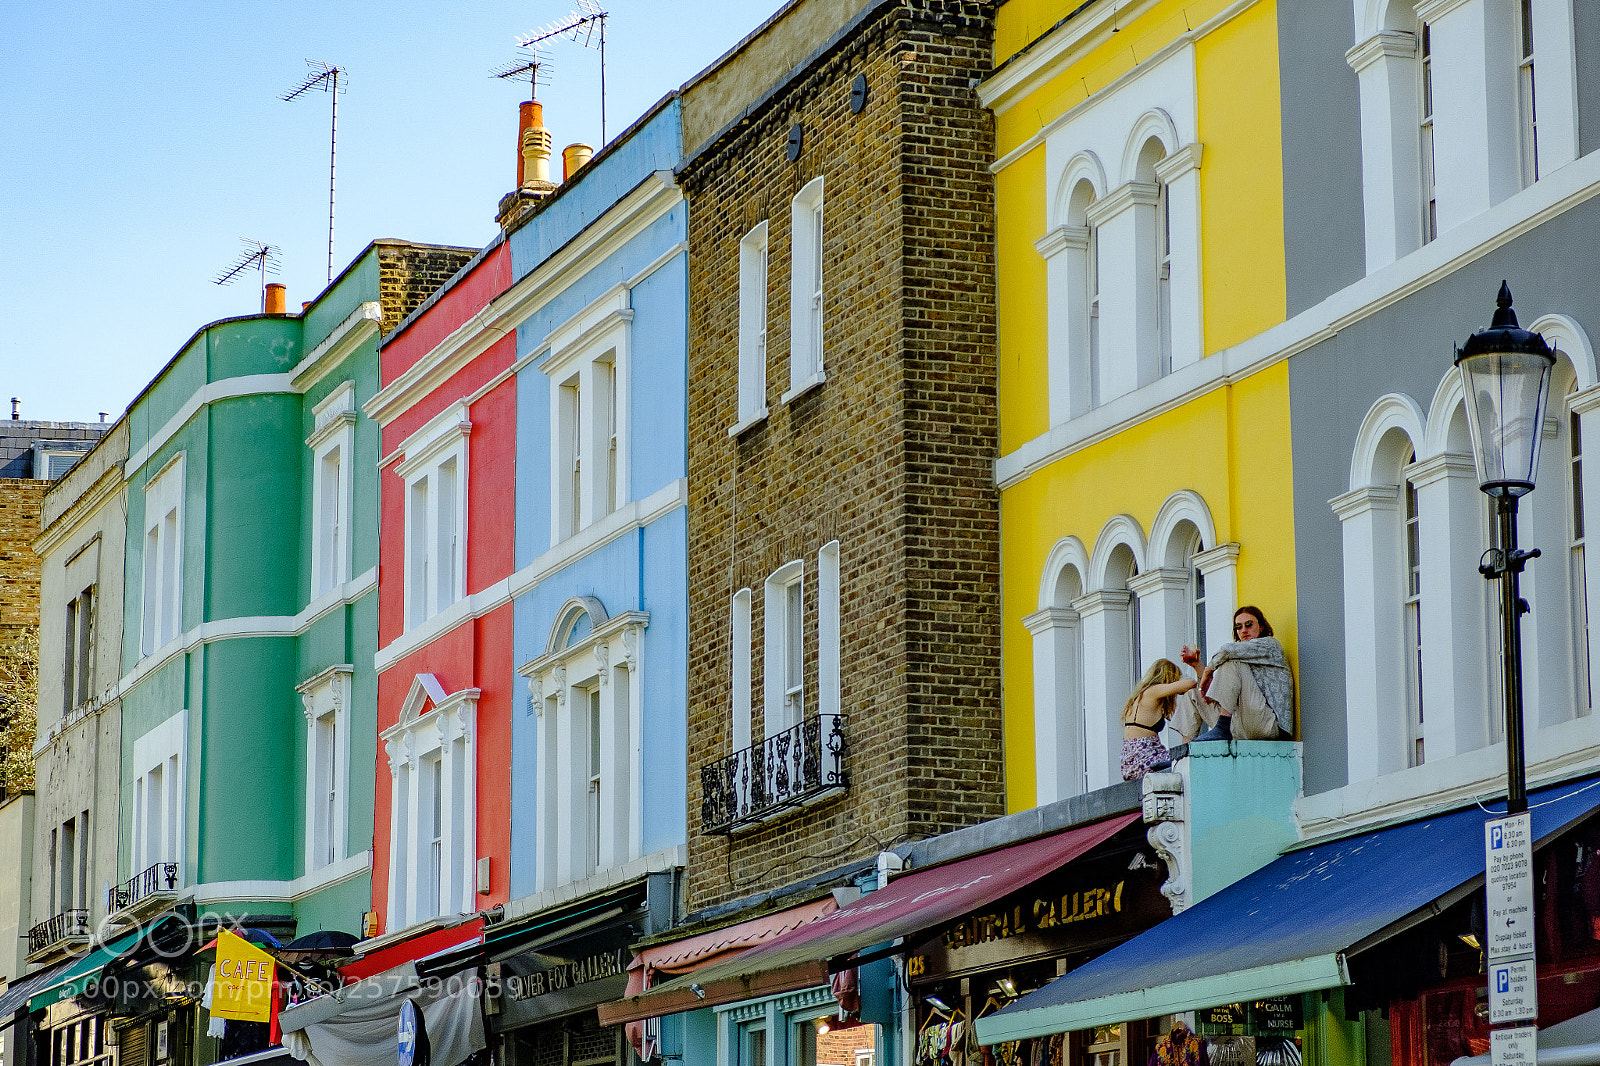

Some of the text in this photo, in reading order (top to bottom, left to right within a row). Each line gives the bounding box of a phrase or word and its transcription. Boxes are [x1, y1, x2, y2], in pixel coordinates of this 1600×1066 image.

[1494, 852, 1524, 864] Pay by phone
[1490, 864, 1501, 873] 020
[1501, 862, 1514, 871] 7023
[1490, 871, 1528, 884] quoting location
[942, 905, 1026, 950] CENTRAL
[1033, 880, 1125, 929] GALLERY
[1492, 910, 1501, 918] Pay
[1508, 906, 1528, 915] machine
[1495, 930, 1527, 942] Display ticket
[220, 959, 269, 981] CAFE
[548, 965, 569, 992] FOX
[572, 948, 623, 985] GALLERY
[1511, 964, 1526, 974] Permit
[1510, 974, 1528, 983] holders
[1514, 984, 1524, 993] only
[1502, 997, 1523, 1006] Saturday
[1265, 1004, 1292, 1012] CALM
[1210, 1014, 1233, 1023] BOSS
[1267, 1020, 1294, 1028] NURSE
[1495, 1032, 1512, 1040] Antique
[1503, 1051, 1524, 1060] Saturday
